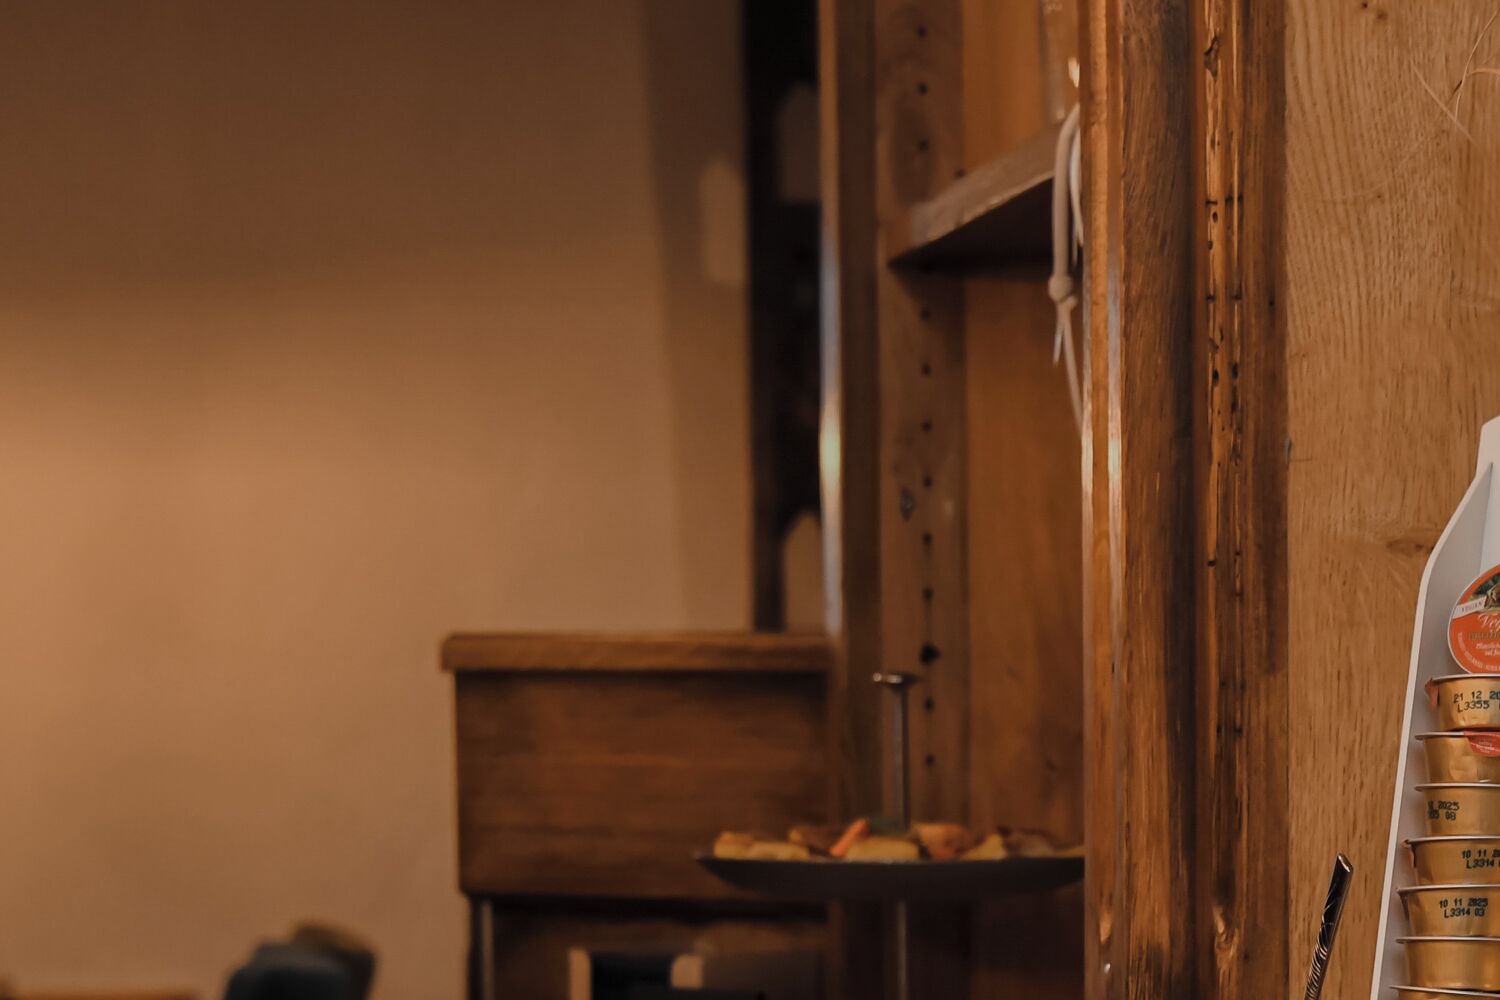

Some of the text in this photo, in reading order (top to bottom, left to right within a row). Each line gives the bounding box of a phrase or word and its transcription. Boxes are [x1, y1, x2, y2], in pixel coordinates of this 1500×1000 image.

[1453, 693, 1463, 703] 21
[1472, 691, 1482, 699] 12
[1438, 800, 1459, 811] 2025
[1462, 850, 1471, 859] 10
[1478, 849, 1487, 857] 11
[1439, 899, 1448, 908] 10
[1454, 898, 1462, 906] 11
